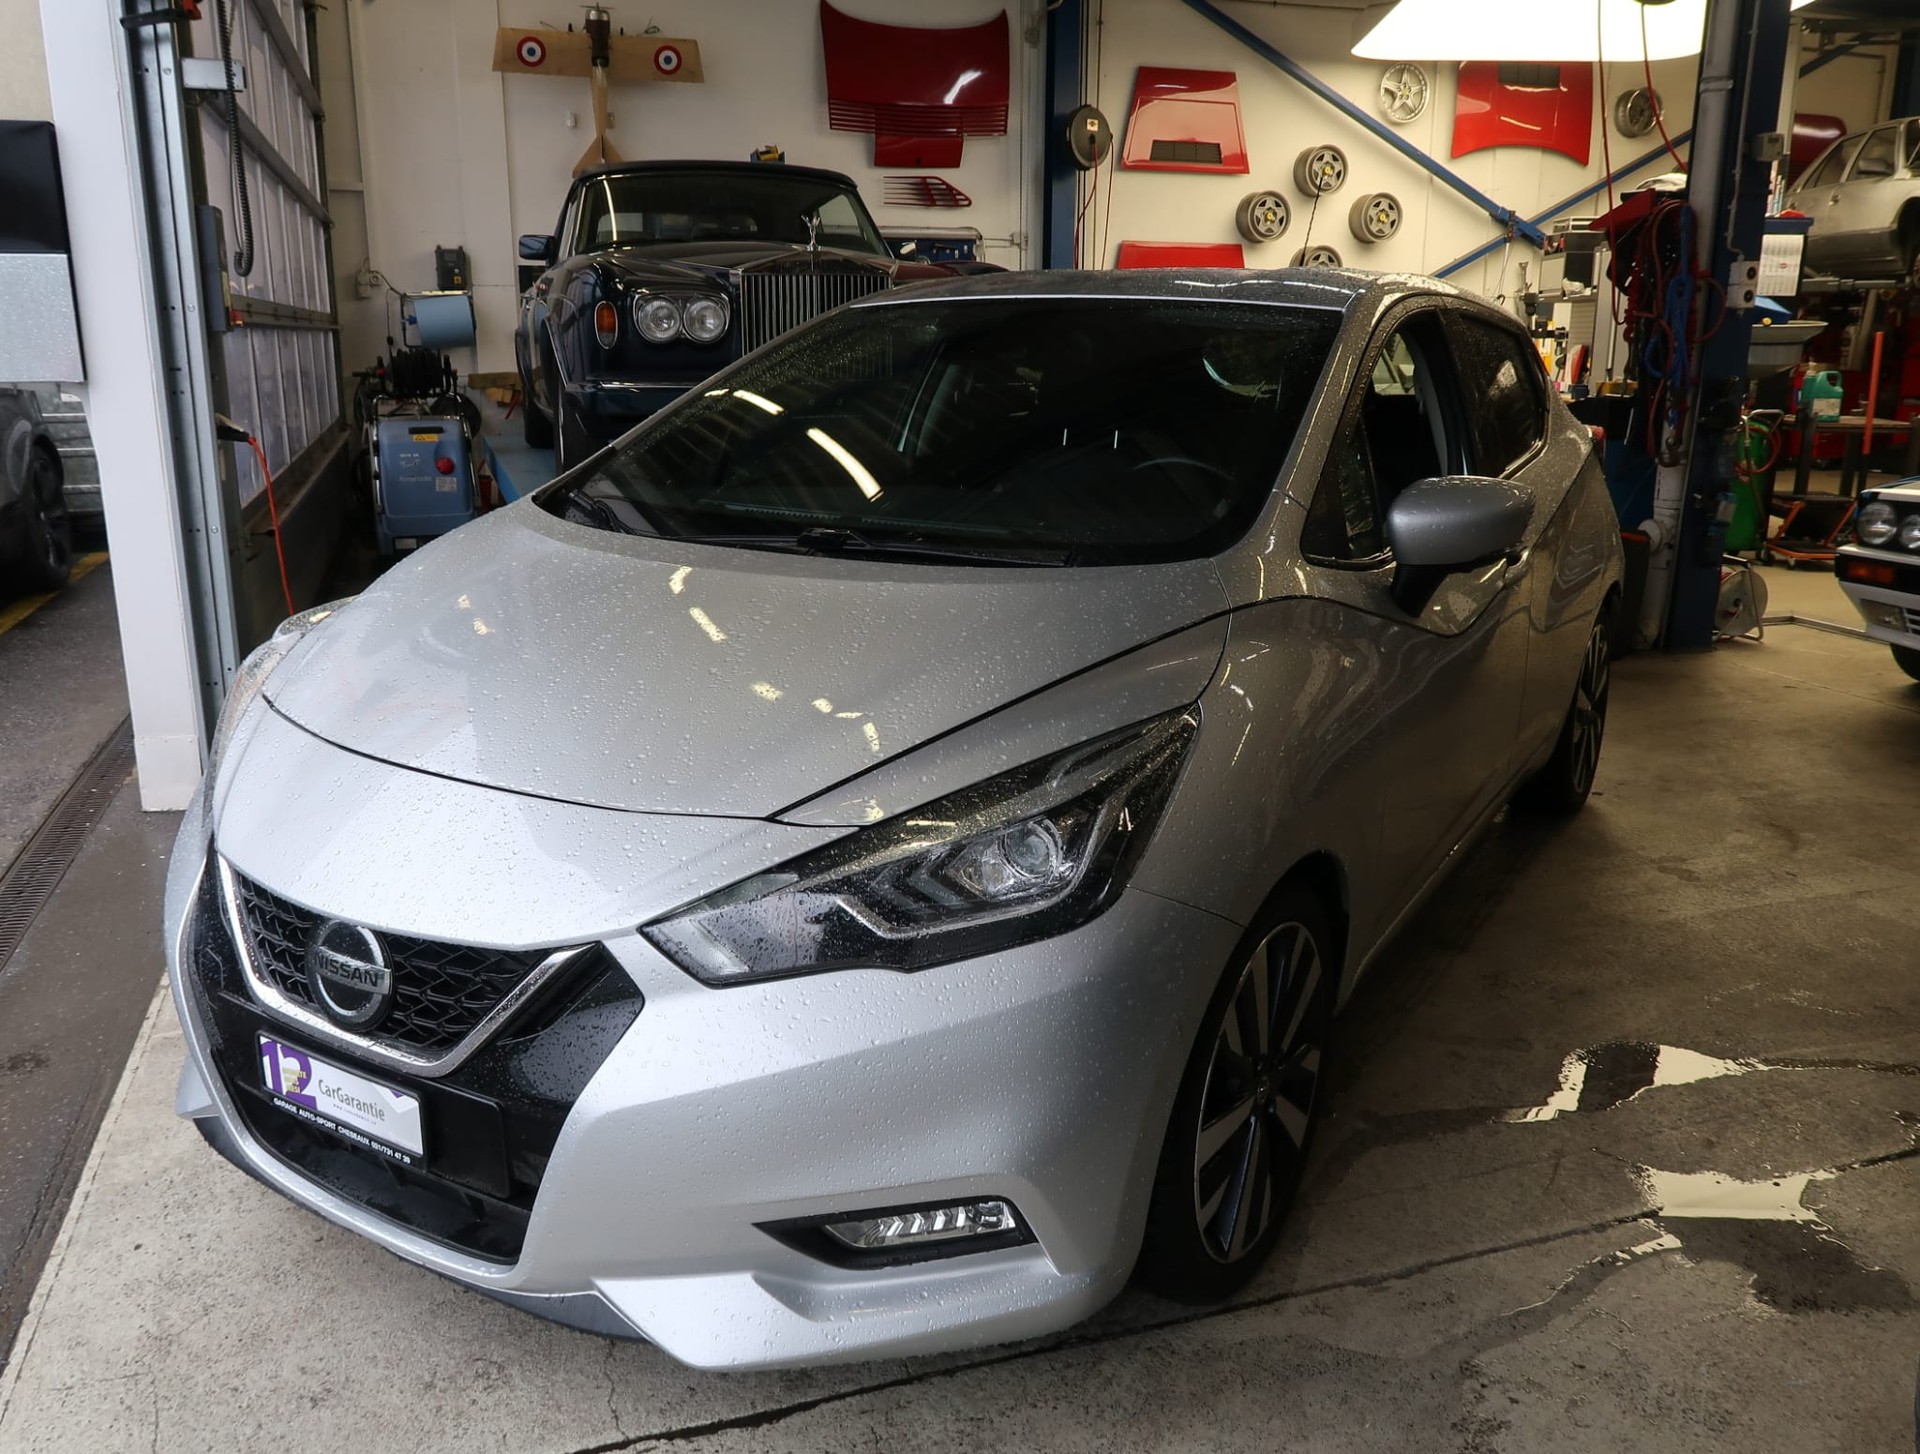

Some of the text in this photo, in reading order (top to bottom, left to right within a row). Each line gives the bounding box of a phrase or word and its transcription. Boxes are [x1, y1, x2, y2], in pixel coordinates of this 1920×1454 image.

[315, 950, 378, 988] NISSAN
[260, 1040, 318, 1111] 12
[318, 1079, 385, 1122] CarGarantie
